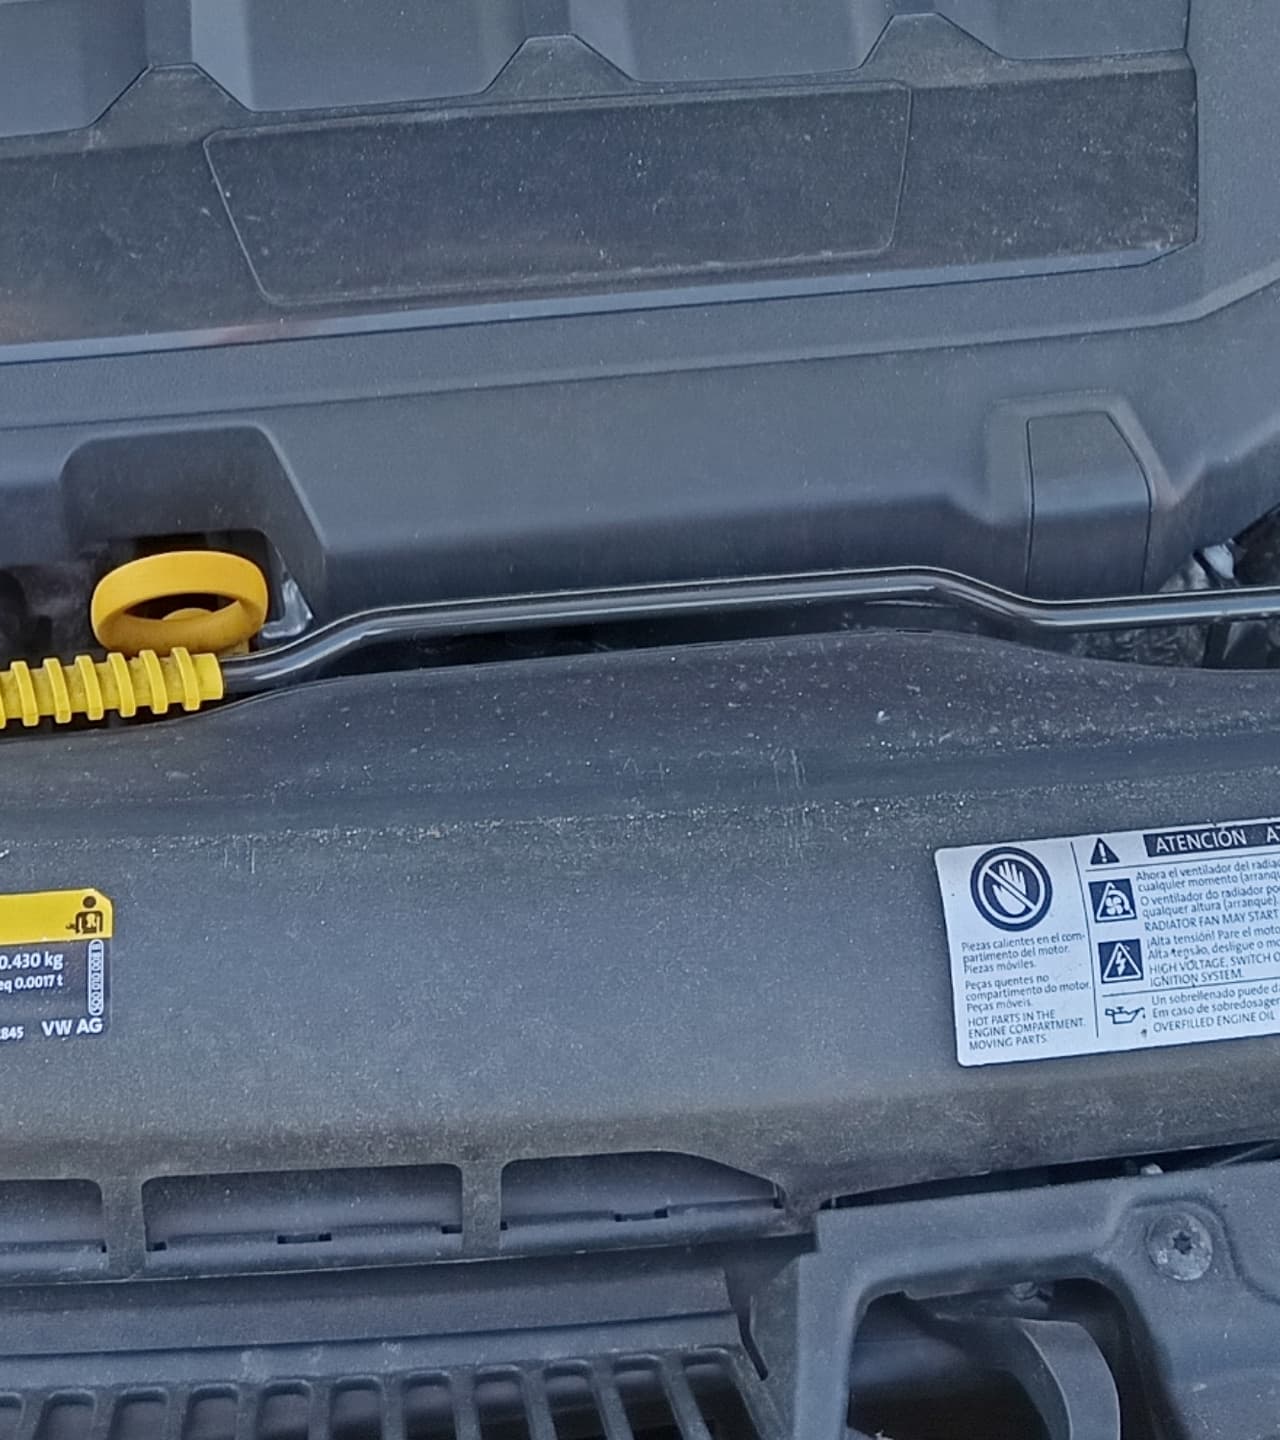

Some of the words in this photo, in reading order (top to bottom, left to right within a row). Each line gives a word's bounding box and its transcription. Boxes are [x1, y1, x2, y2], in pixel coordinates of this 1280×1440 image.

[1156, 827, 1247, 854] ATENCIÓN
[1135, 870, 1167, 882] Ahora
[1168, 867, 1179, 879] el
[1179, 863, 1232, 877] ventilador
[1233, 860, 1250, 872] del
[1137, 879, 1186, 896] cualquier
[1187, 874, 1239, 888] momento
[1139, 895, 1150, 907] O
[1150, 891, 1203, 906] ventilador
[1205, 889, 1220, 901] do
[1221, 885, 1264, 899] radiador
[1140, 904, 1189, 920] qualquer
[1191, 901, 1222, 913] altura
[1144, 917, 1198, 932] RADIATOR
[1198, 915, 1220, 927] FAN
[1221, 912, 1246, 925] MAY
[1247, 908, 1279, 922] START
[961, 941, 992, 953] Piezas
[992, 936, 1036, 950] calientes
[1036, 935, 1050, 945] en
[1050, 932, 1060, 944] el
[1173, 930, 1216, 945] tensión!
[1217, 929, 1240, 941] Pare
[1241, 926, 1252, 938] el
[962, 949, 1022, 966] partimento
[1020, 946, 1037, 958] del
[1038, 944, 1070, 956] motor.
[1147, 947, 1170, 961] Alta
[1211, 938, 1257, 954] desligue
[1255, 938, 1265, 949] o
[44, 950, 64, 971] kg
[963, 964, 994, 975] Piezas
[1148, 961, 1178, 976] HIGH
[1230, 951, 1272, 967] SWITCH
[14, 974, 55, 989] 0.0017
[56, 974, 64, 987] t
[964, 980, 993, 993] Peças
[994, 975, 1035, 990] quentes
[1036, 974, 1050, 984] no
[1150, 973, 1199, 988] IGNITION
[965, 986, 1043, 1005] compartimento
[1044, 984, 1058, 994] do
[1059, 981, 1091, 992] motor.
[1151, 994, 1167, 1006] Un
[1169, 988, 1236, 1005] sobrellenado
[1236, 984, 1270, 1000] puede
[966, 1001, 995, 1014] Peças
[1152, 1008, 1169, 1019] Em
[1170, 1005, 1195, 1018] caso
[1196, 1003, 1210, 1015] de
[41, 1019, 73, 1037] VW
[76, 1017, 103, 1035] AG
[967, 1015, 989, 1028] HOT
[991, 1012, 1021, 1026] PARTS
[1022, 1011, 1034, 1022] IN
[1036, 1009, 1055, 1020] THE
[1152, 1016, 1215, 1033] OVERFILLED
[1216, 1012, 1257, 1027] ENGINE
[1258, 1010, 1276, 1022] OIL
[968, 1025, 1006, 1039] ENGINE
[968, 1036, 1013, 1051] MOVING
